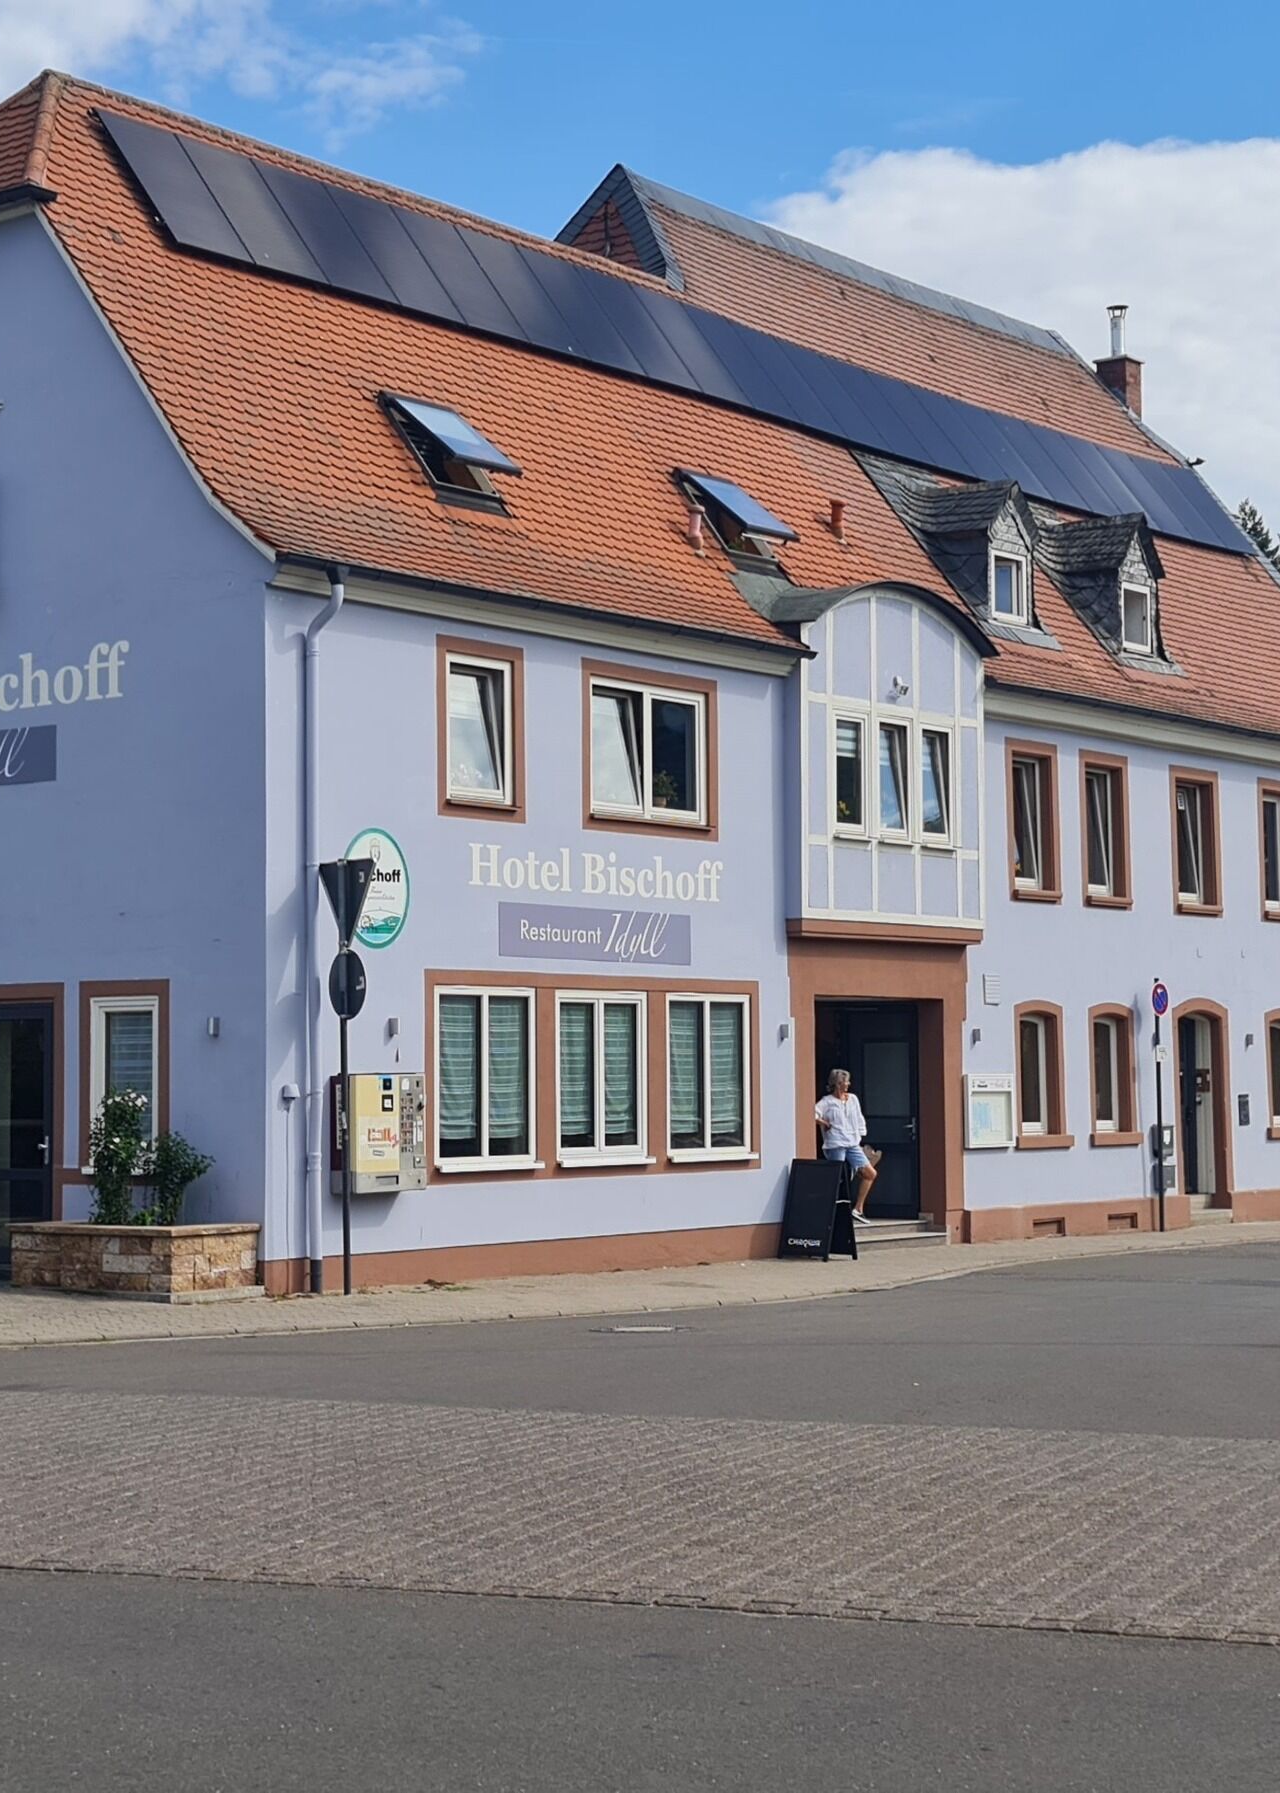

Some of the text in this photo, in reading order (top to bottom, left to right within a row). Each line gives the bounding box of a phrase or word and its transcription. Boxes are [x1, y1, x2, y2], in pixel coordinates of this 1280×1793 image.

[468, 842, 724, 903] Hotel Bischoff
[519, 912, 672, 962] Restaurant Idyll
